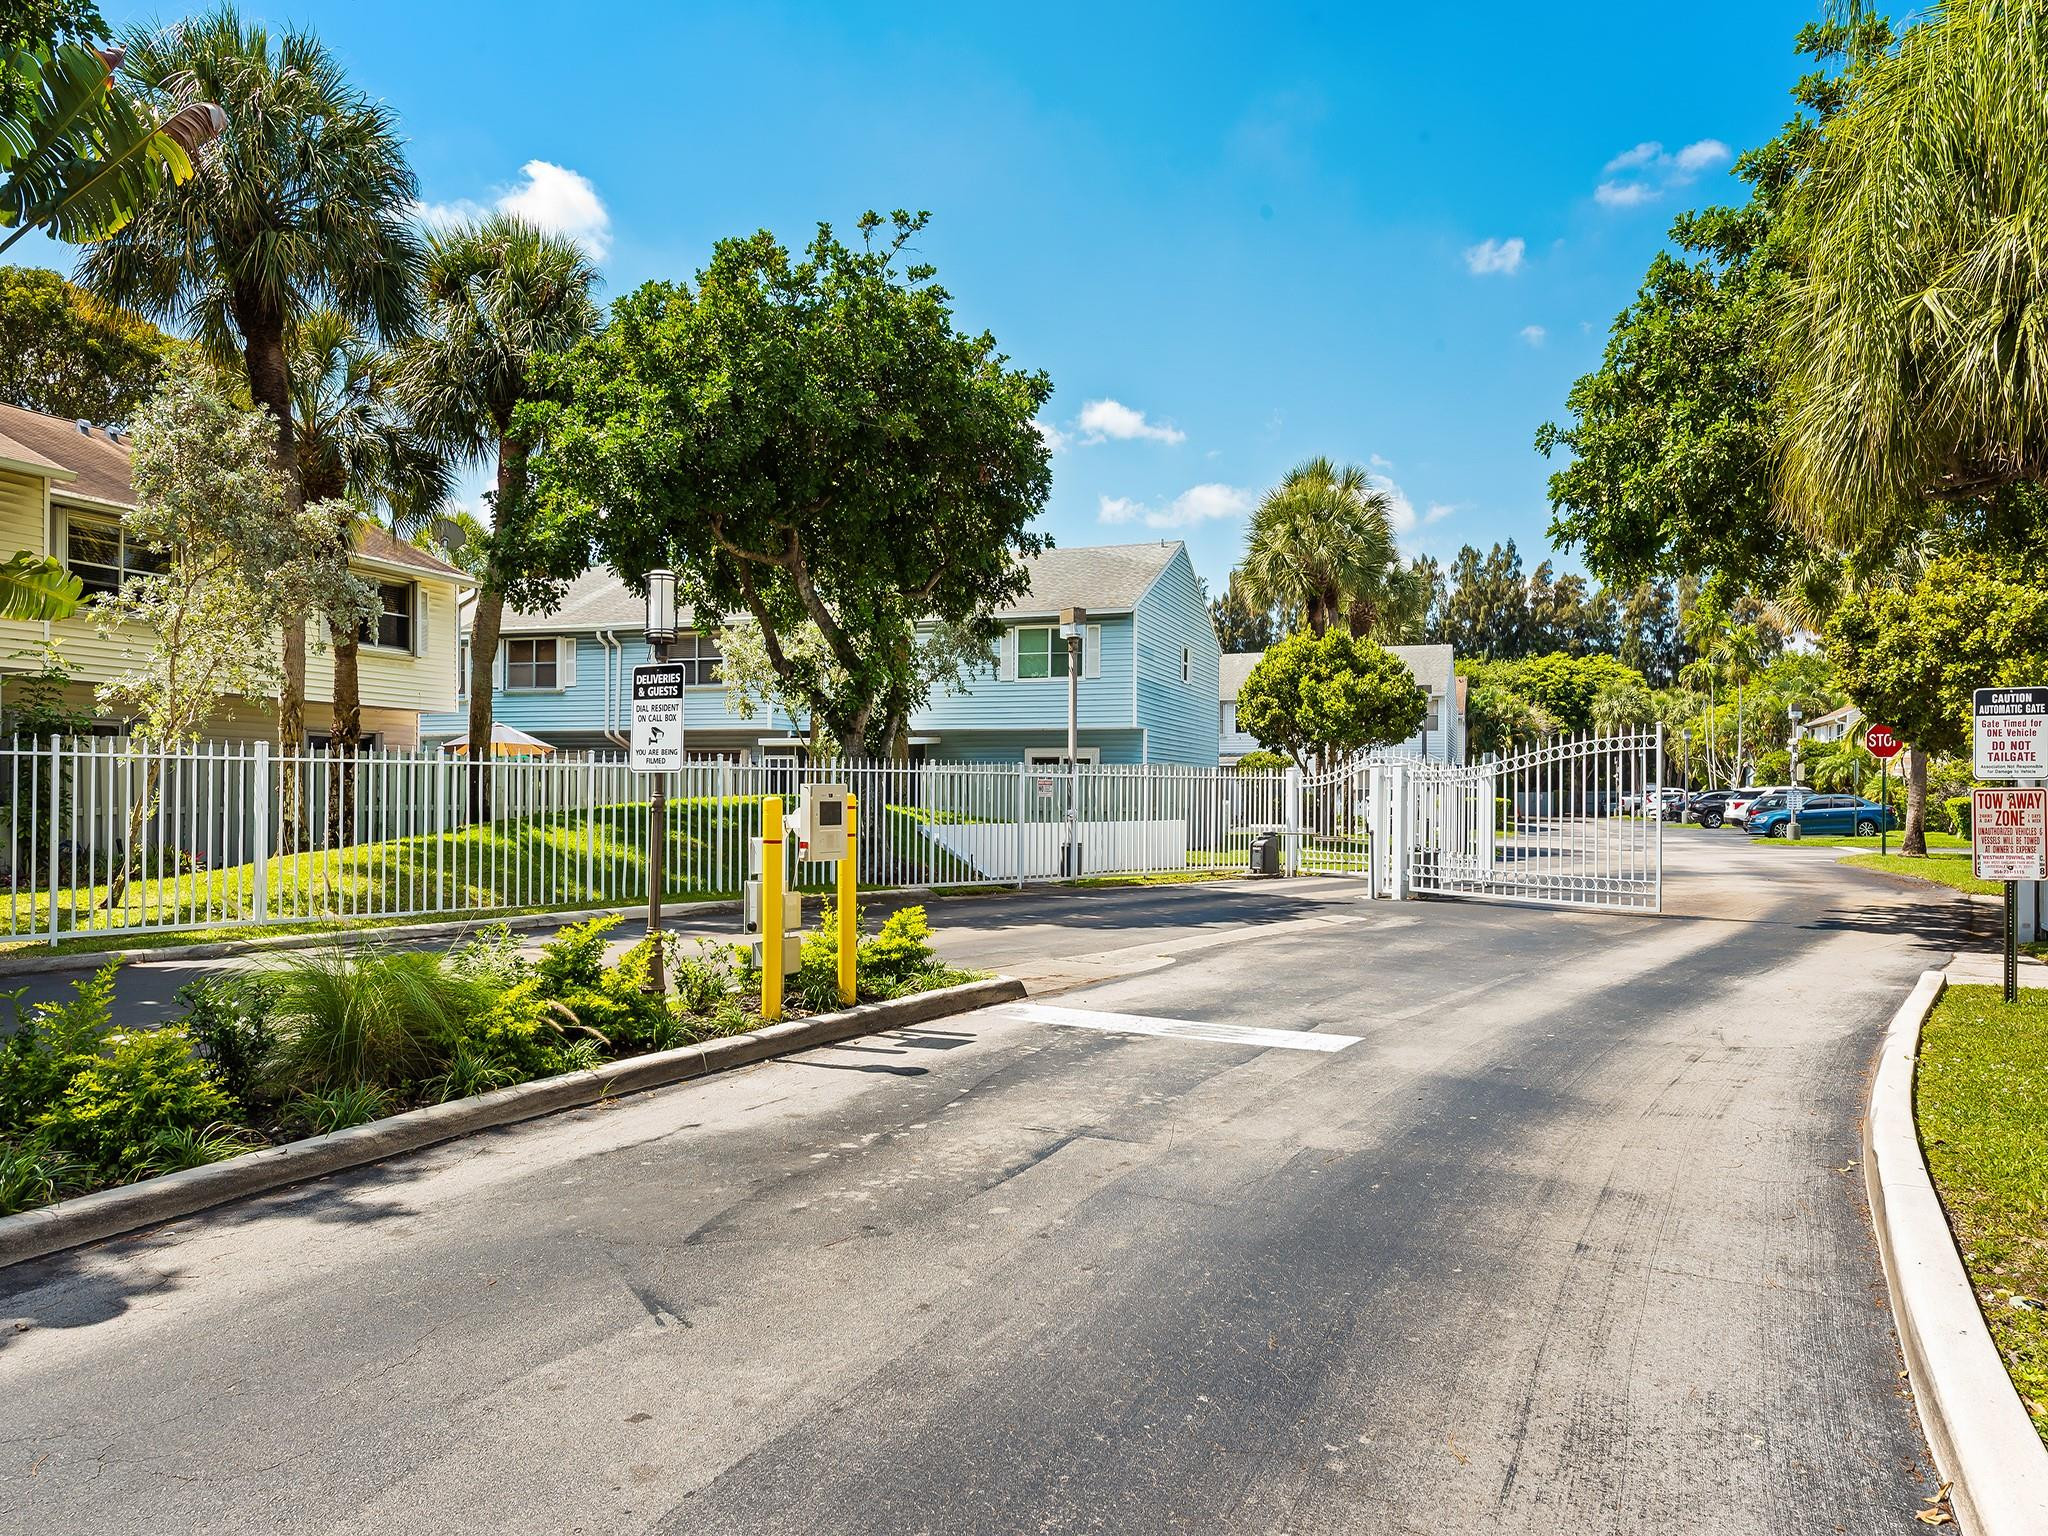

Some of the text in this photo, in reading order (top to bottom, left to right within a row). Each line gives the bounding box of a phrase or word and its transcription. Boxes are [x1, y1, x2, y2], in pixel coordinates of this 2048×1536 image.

[636, 673, 680, 684] DELIVERIES
[638, 686, 678, 696] & GUESTS
[1992, 693, 2032, 703] CAUTION
[1979, 704, 2046, 714] AUTOMATIC GATE
[638, 714, 646, 722] ON
[2003, 720, 2026, 728] Timed
[2030, 719, 2042, 727] for
[1986, 729, 2002, 737] ONE
[1868, 734, 1896, 747] STO
[1992, 741, 2031, 750] DO NOT
[1988, 752, 2036, 762] TAILGATE
[1978, 793, 2042, 809] TOW AWAY
[1996, 810, 2025, 826] ZONE
[1978, 828, 2013, 836] UNAUTHORIZED
[2015, 828, 2037, 836] VEHICLES
[1981, 836, 2040, 844] VESSELS WILL BE TOWED
[1985, 846, 2036, 854] AT OWNER'S EXPENSE
